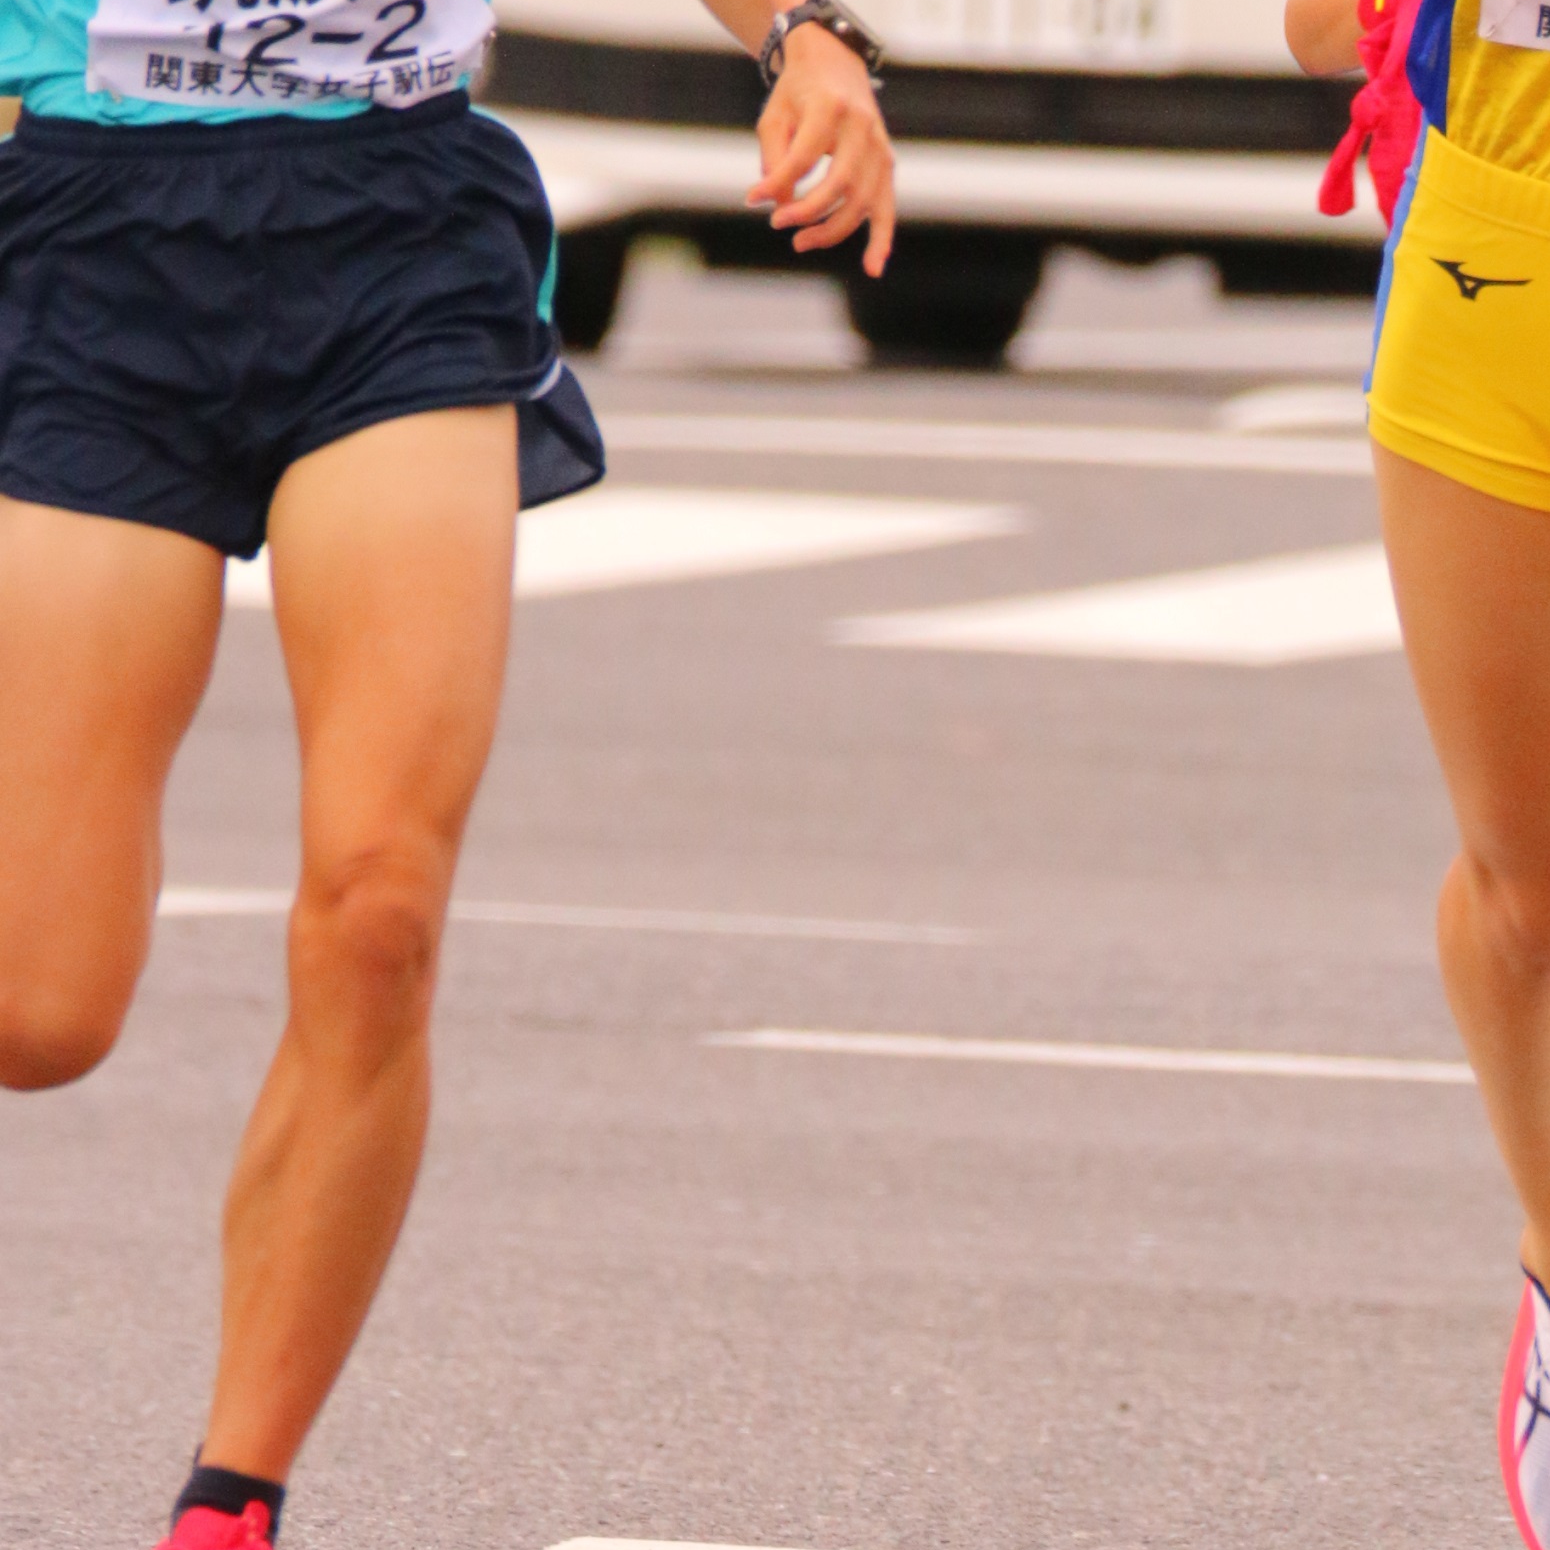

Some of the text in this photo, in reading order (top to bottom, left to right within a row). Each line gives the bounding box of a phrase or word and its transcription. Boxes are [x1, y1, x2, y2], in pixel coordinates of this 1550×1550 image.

[145, 51, 457, 101] 関東大学女子駅伝
